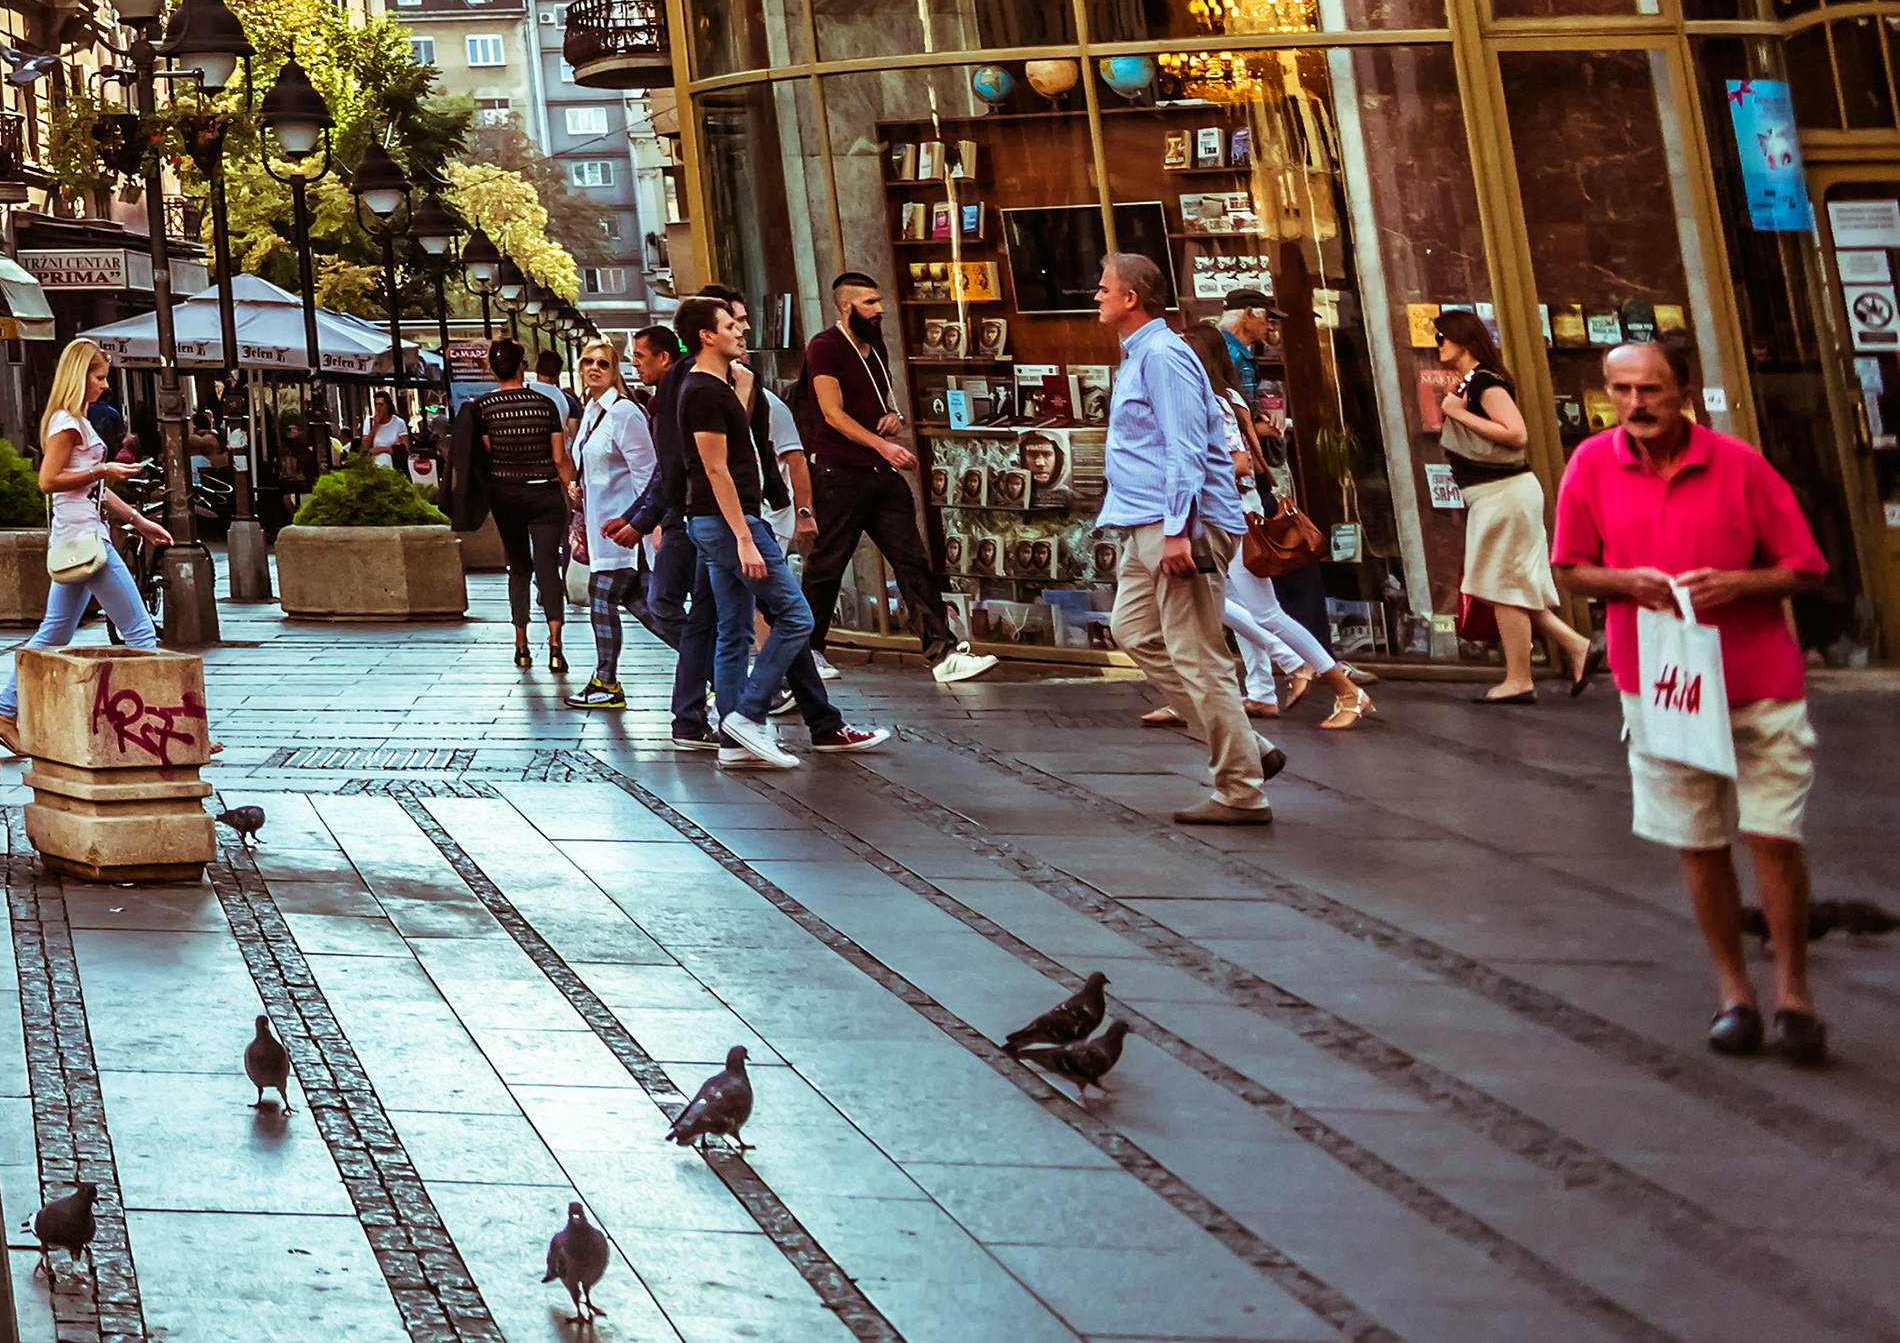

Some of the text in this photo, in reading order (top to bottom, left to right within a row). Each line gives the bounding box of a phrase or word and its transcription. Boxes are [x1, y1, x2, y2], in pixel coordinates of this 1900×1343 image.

[22, 255, 120, 269] TRŽNI CENTAR
[242, 345, 274, 359] Jelen
[322, 354, 355, 368] Jelen
